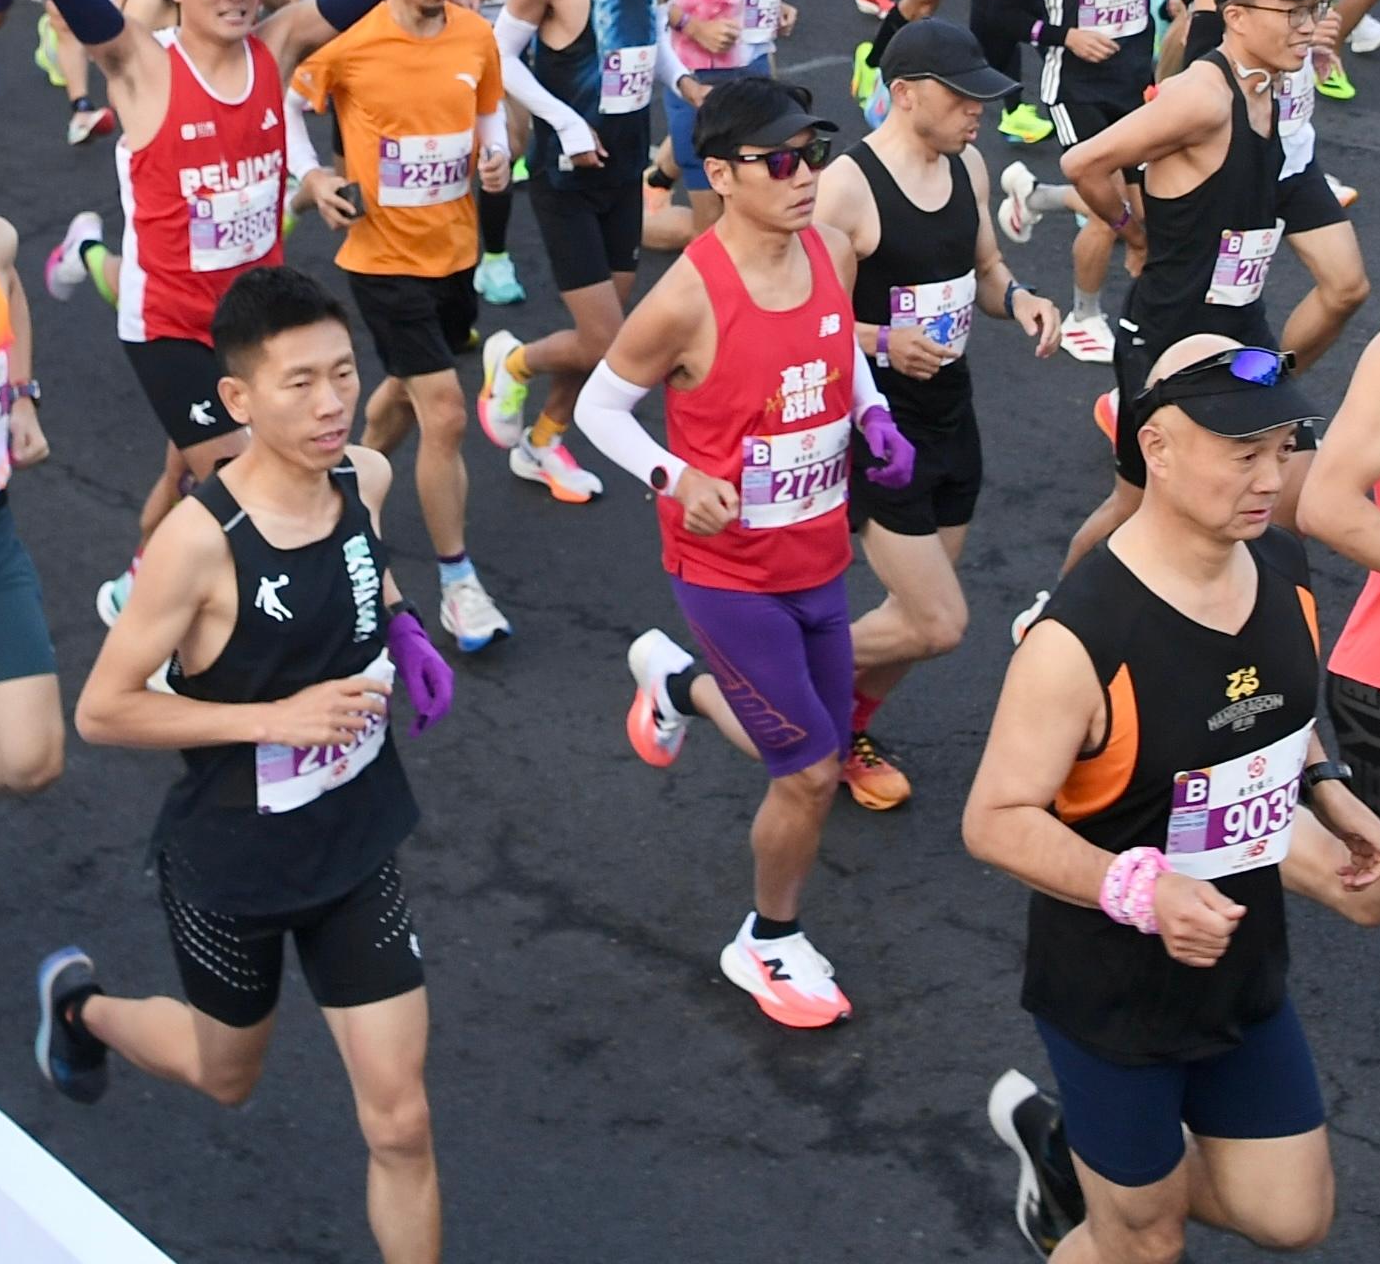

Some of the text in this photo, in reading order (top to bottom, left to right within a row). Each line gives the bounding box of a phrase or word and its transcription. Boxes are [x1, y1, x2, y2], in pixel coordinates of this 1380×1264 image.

[608, 53, 621, 71] C
[386, 141, 399, 159] B
[1227, 236, 1240, 253] B
[899, 292, 916, 312] B
[752, 443, 770, 465] B
[1186, 778, 1207, 803] B
